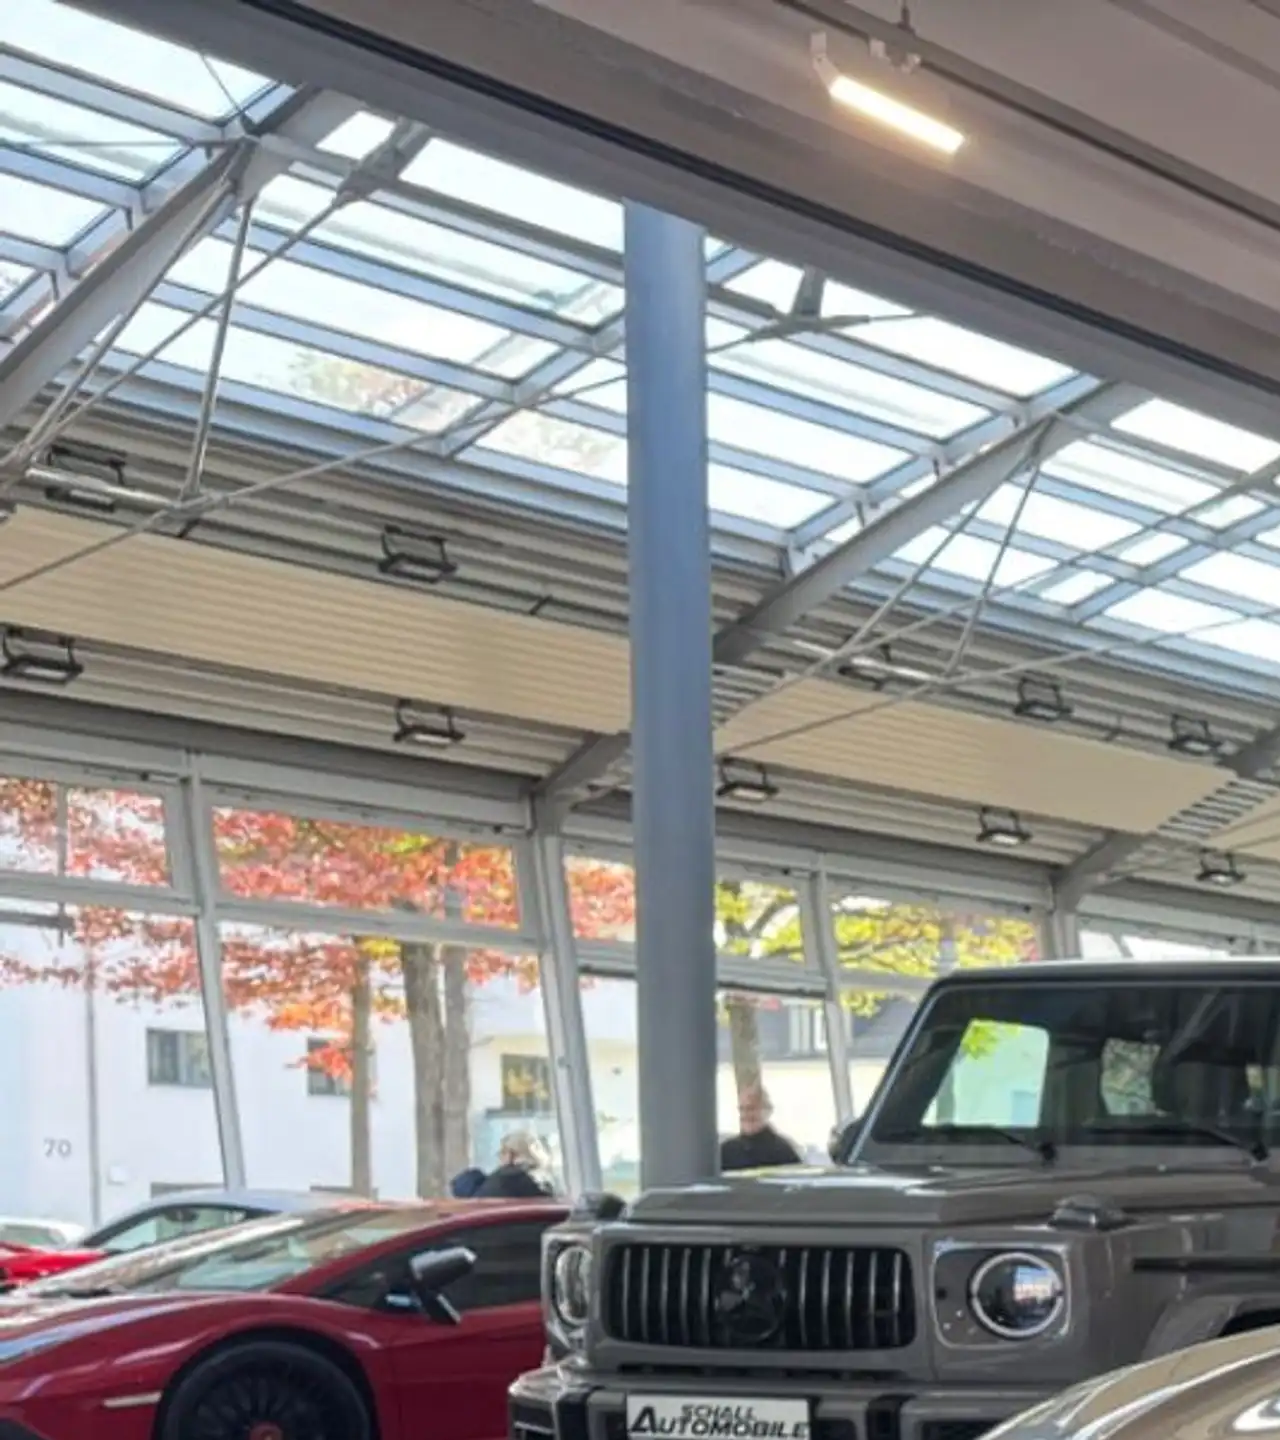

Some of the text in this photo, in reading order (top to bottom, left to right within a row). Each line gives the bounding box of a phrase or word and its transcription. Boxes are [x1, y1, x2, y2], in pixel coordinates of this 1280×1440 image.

[43, 1137, 73, 1159] 70
[629, 1405, 808, 1438] AUTOMOBILE
[682, 1404, 755, 1422] SCHALL
